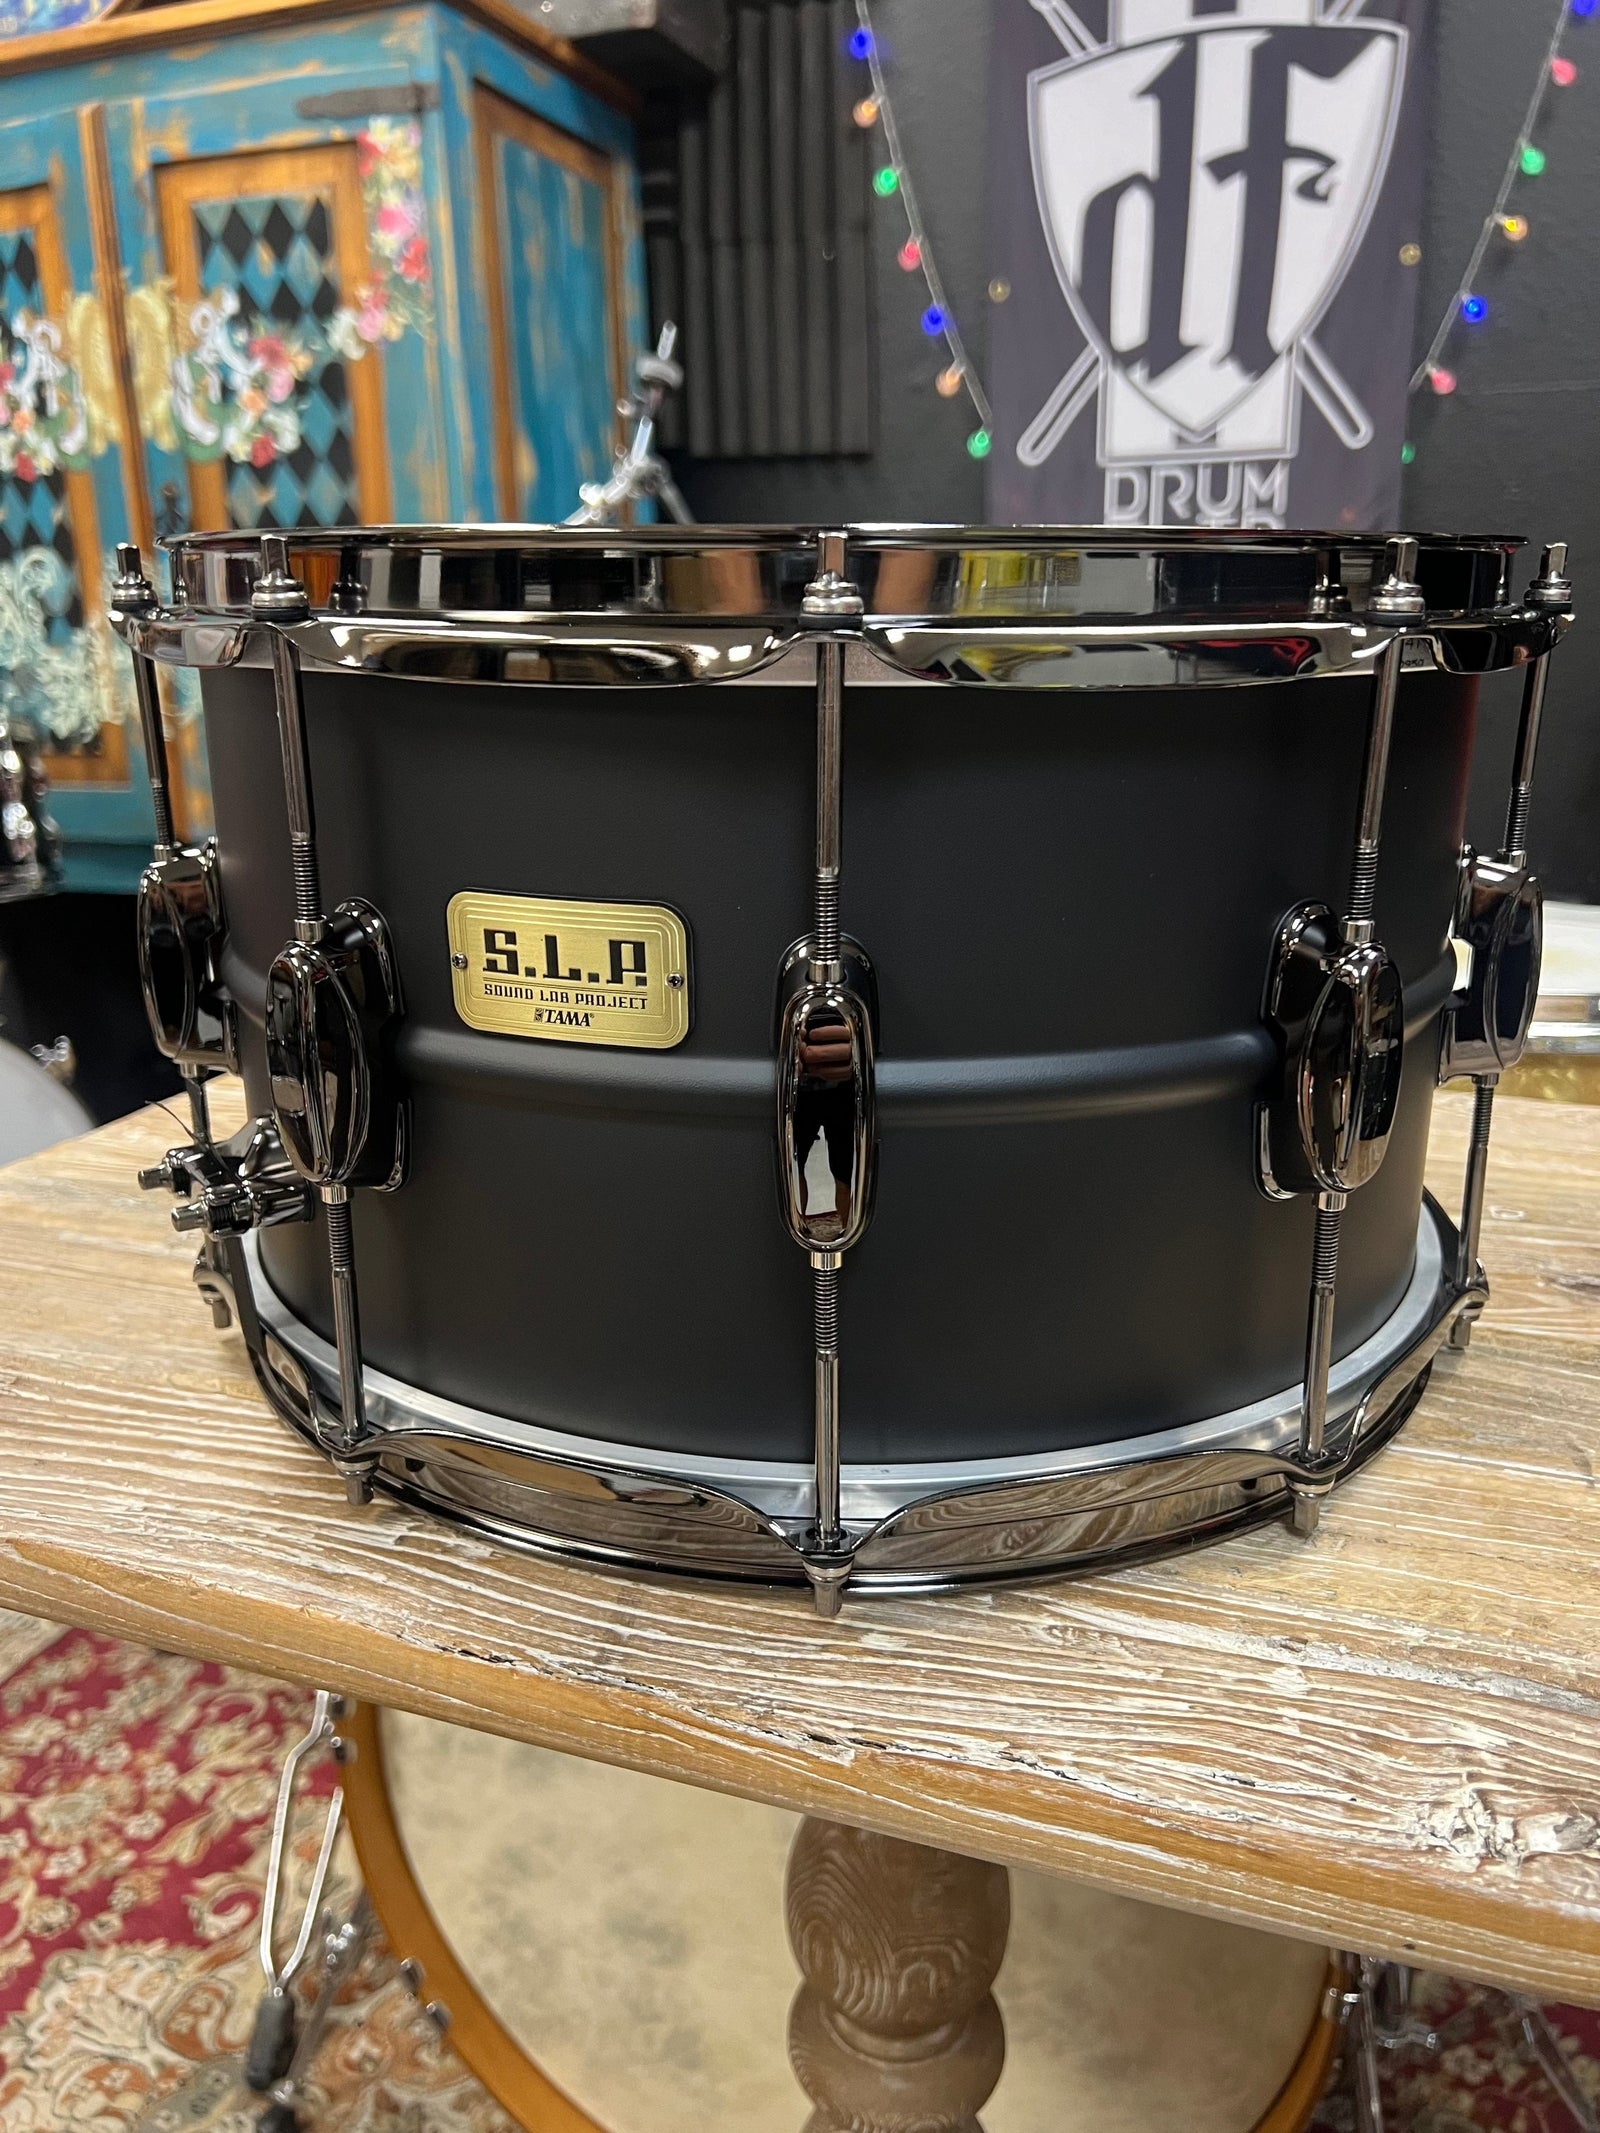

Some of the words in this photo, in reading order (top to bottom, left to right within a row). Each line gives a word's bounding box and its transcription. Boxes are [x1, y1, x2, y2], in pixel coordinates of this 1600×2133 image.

[1104, 460, 1289, 519] DRUM
[484, 984, 533, 1000] SOUND
[540, 990, 569, 1003] LAB
[575, 993, 648, 1010] PROJECT
